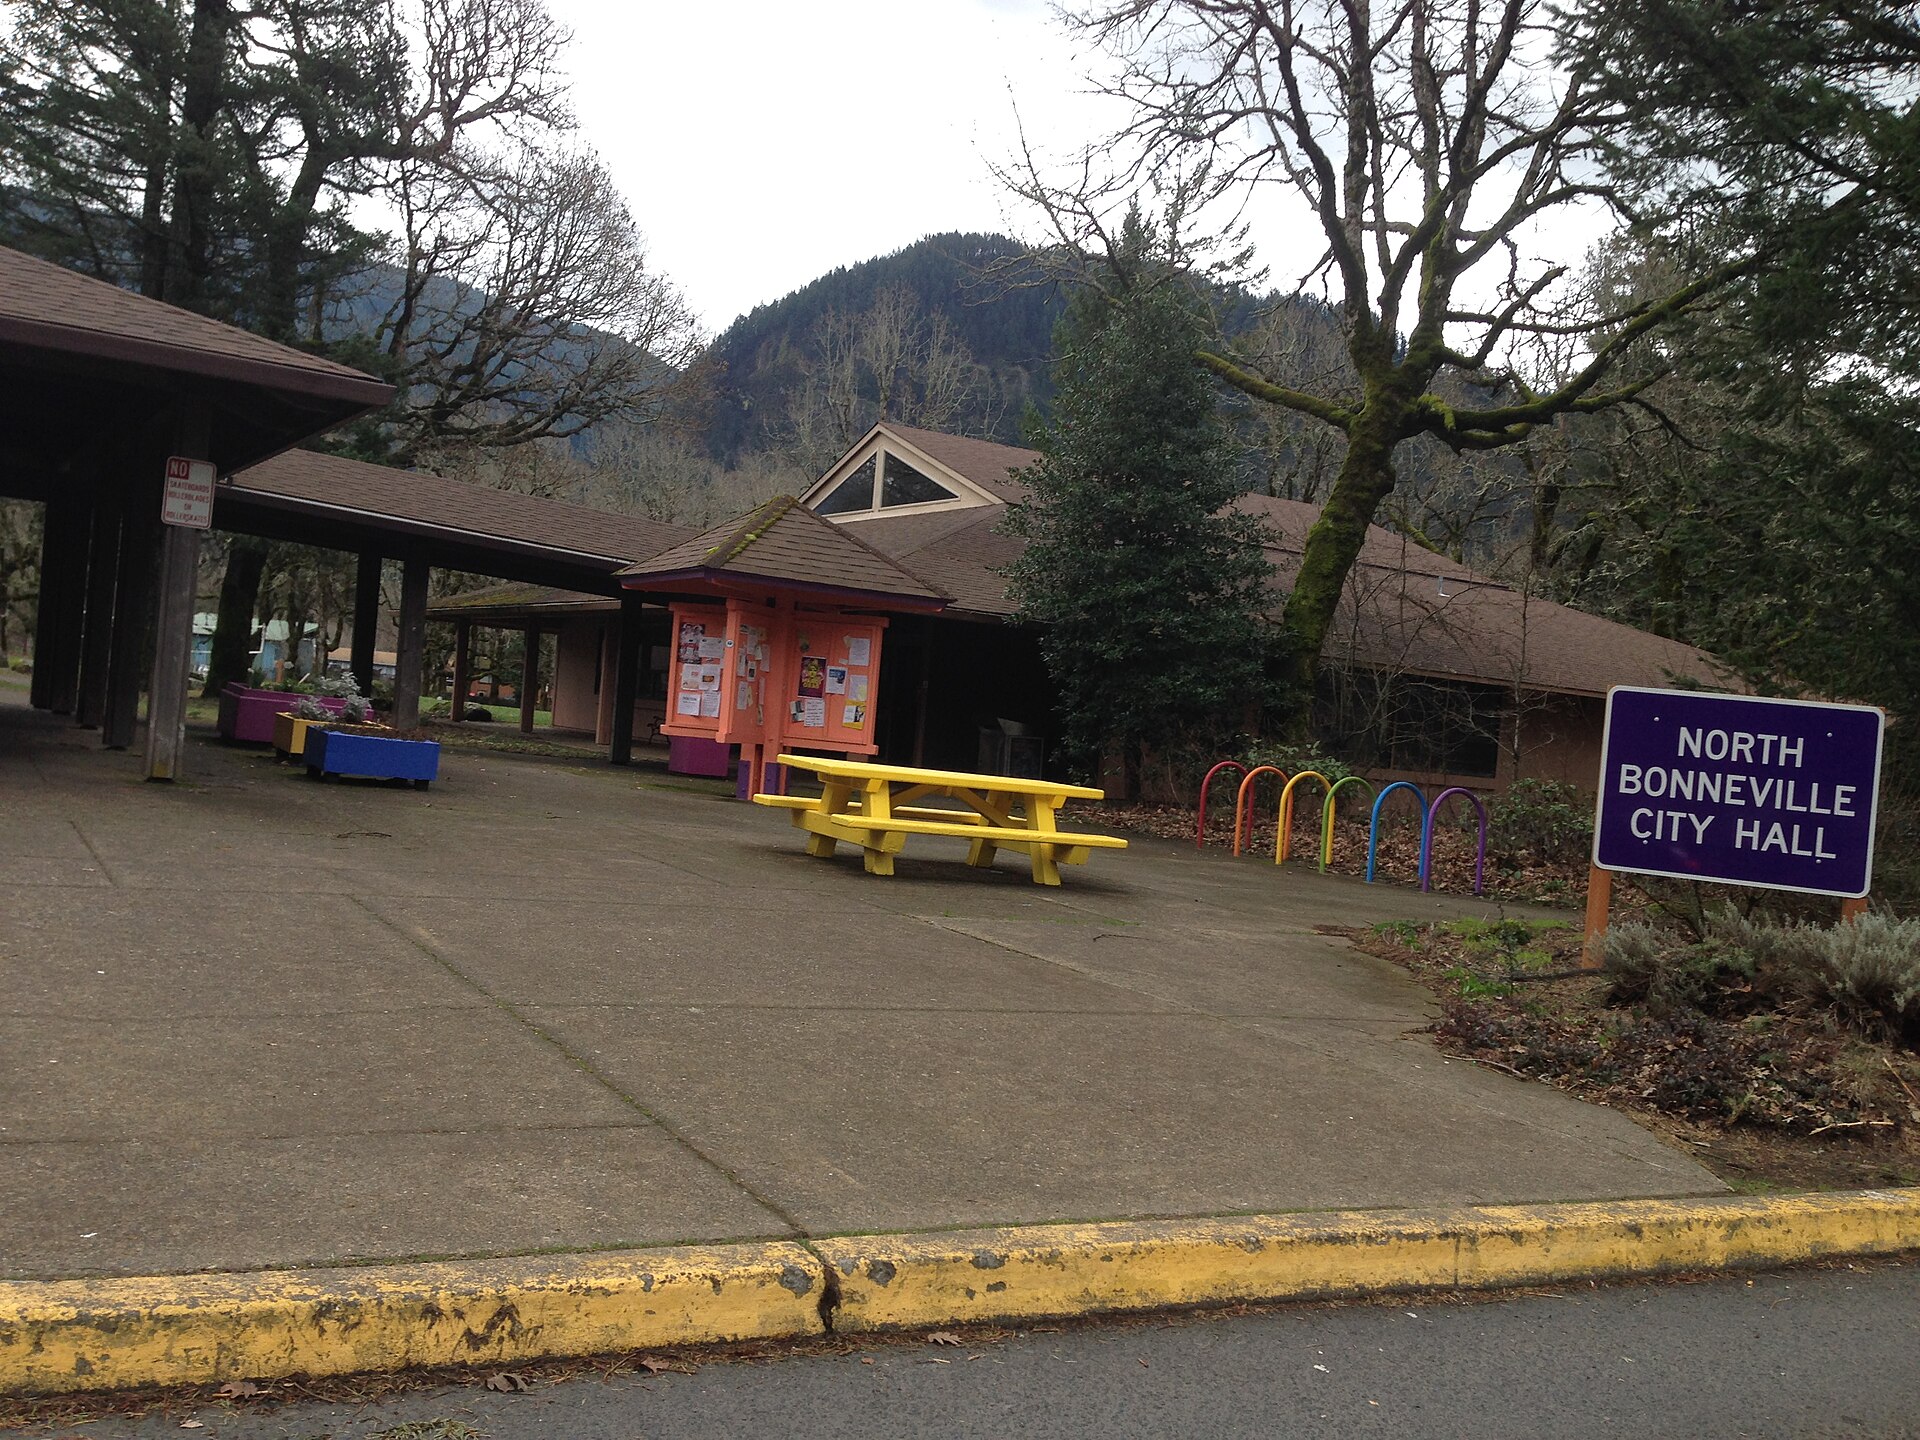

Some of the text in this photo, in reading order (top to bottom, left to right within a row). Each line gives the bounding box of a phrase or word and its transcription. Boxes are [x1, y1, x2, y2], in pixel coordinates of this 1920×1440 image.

[169, 481, 210, 493] SKATEBOARDS
[170, 460, 188, 477] NO
[1677, 726, 1804, 768] NORTH
[1618, 763, 1857, 817] BONNEVILLE
[1630, 807, 1837, 860] CITY HALL
